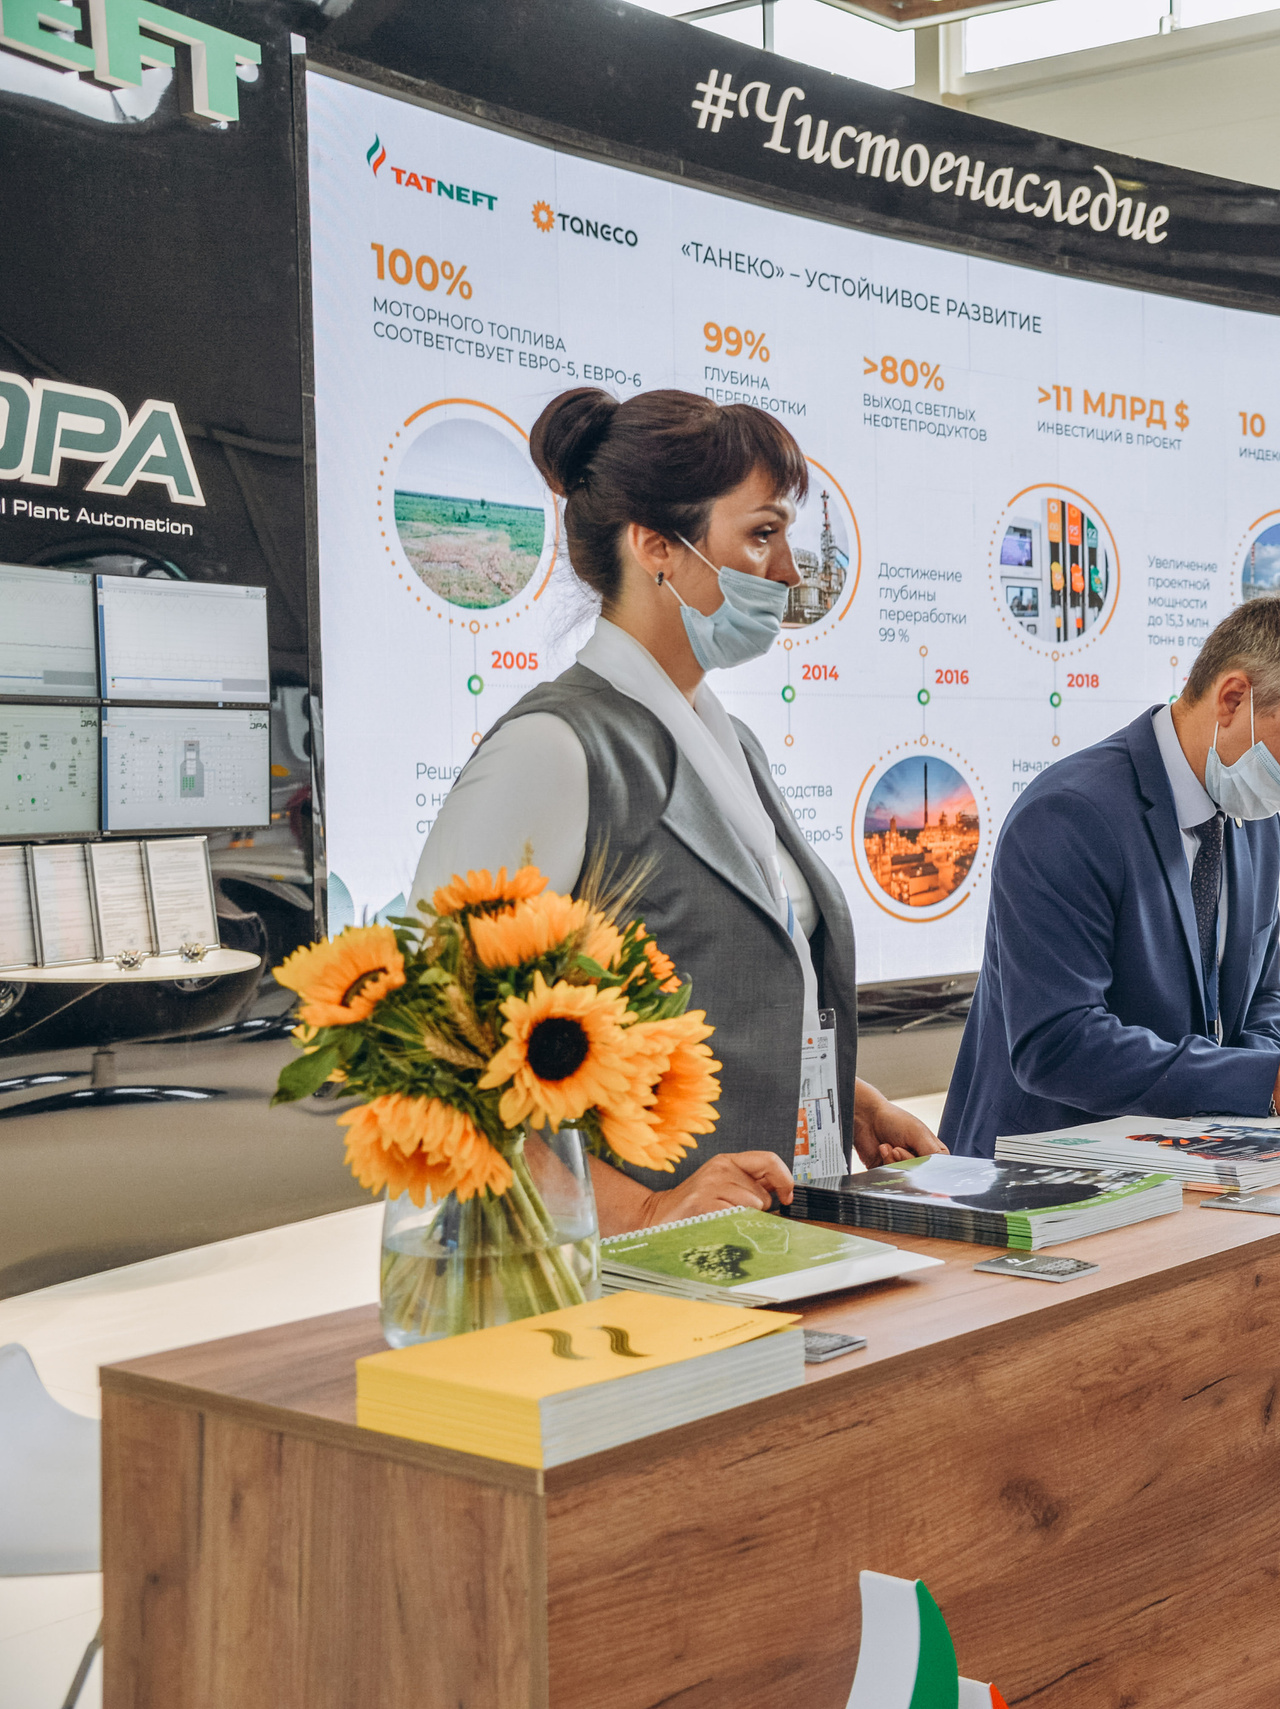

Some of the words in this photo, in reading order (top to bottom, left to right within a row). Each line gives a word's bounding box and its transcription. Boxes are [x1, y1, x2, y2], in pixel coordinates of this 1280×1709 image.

[691, 68, 1170, 245] #Чистоенаследие
[390, 166, 498, 211] TATNEFT
[557, 213, 639, 247] TANECO
[371, 242, 473, 300] 100%
[681, 241, 785, 280] «ТАНЕКО»
[804, 267, 941, 315] УСТОЙЧИВОЕ
[946, 298, 1043, 334] РАЗВИТИЕ
[373, 296, 485, 334] МОТОРНОГО
[488, 321, 567, 352] ТОПЛИВА
[373, 321, 515, 364] СООТВЕТСТВУЕТ
[518, 351, 580, 380] ЕВРО-5,
[583, 364, 642, 388] ЕВРО-6
[703, 321, 771, 363] 99%
[704, 366, 771, 391] ГЛУБИНА
[862, 355, 945, 392] >80%
[863, 393, 913, 415] ВЫХОД
[914, 401, 977, 422] СВЕТЛЫХ
[1037, 384, 1073, 413] >11
[1083, 389, 1167, 430] МЛРД
[1174, 399, 1190, 432] $
[863, 412, 988, 442] НЕФТЕПРОДУКТОВ
[1037, 420, 1123, 443] ИНВЕСТИЦИЙ
[1125, 432, 1134, 444] В
[1136, 433, 1183, 451] ПРОЕКТ
[1238, 411, 1266, 438] 10
[13, 499, 71, 521] Plant
[76, 507, 194, 536] Automation
[878, 562, 963, 583] Достижение
[1147, 555, 1218, 573] Увеличение
[879, 585, 937, 603] глубины
[1147, 577, 1210, 592] проектной
[879, 607, 967, 625] переработки
[1147, 597, 1208, 610] мощности
[1147, 615, 1163, 628] до
[1165, 613, 1185, 629] 15,3
[1186, 618, 1210, 628] млн
[879, 627, 896, 643] 99
[1147, 634, 1175, 646] тонн
[1178, 636, 1185, 647] в
[491, 650, 539, 670] 2005
[802, 664, 839, 681] 2014
[935, 669, 970, 685] 2016
[1066, 673, 1100, 688] 2018
